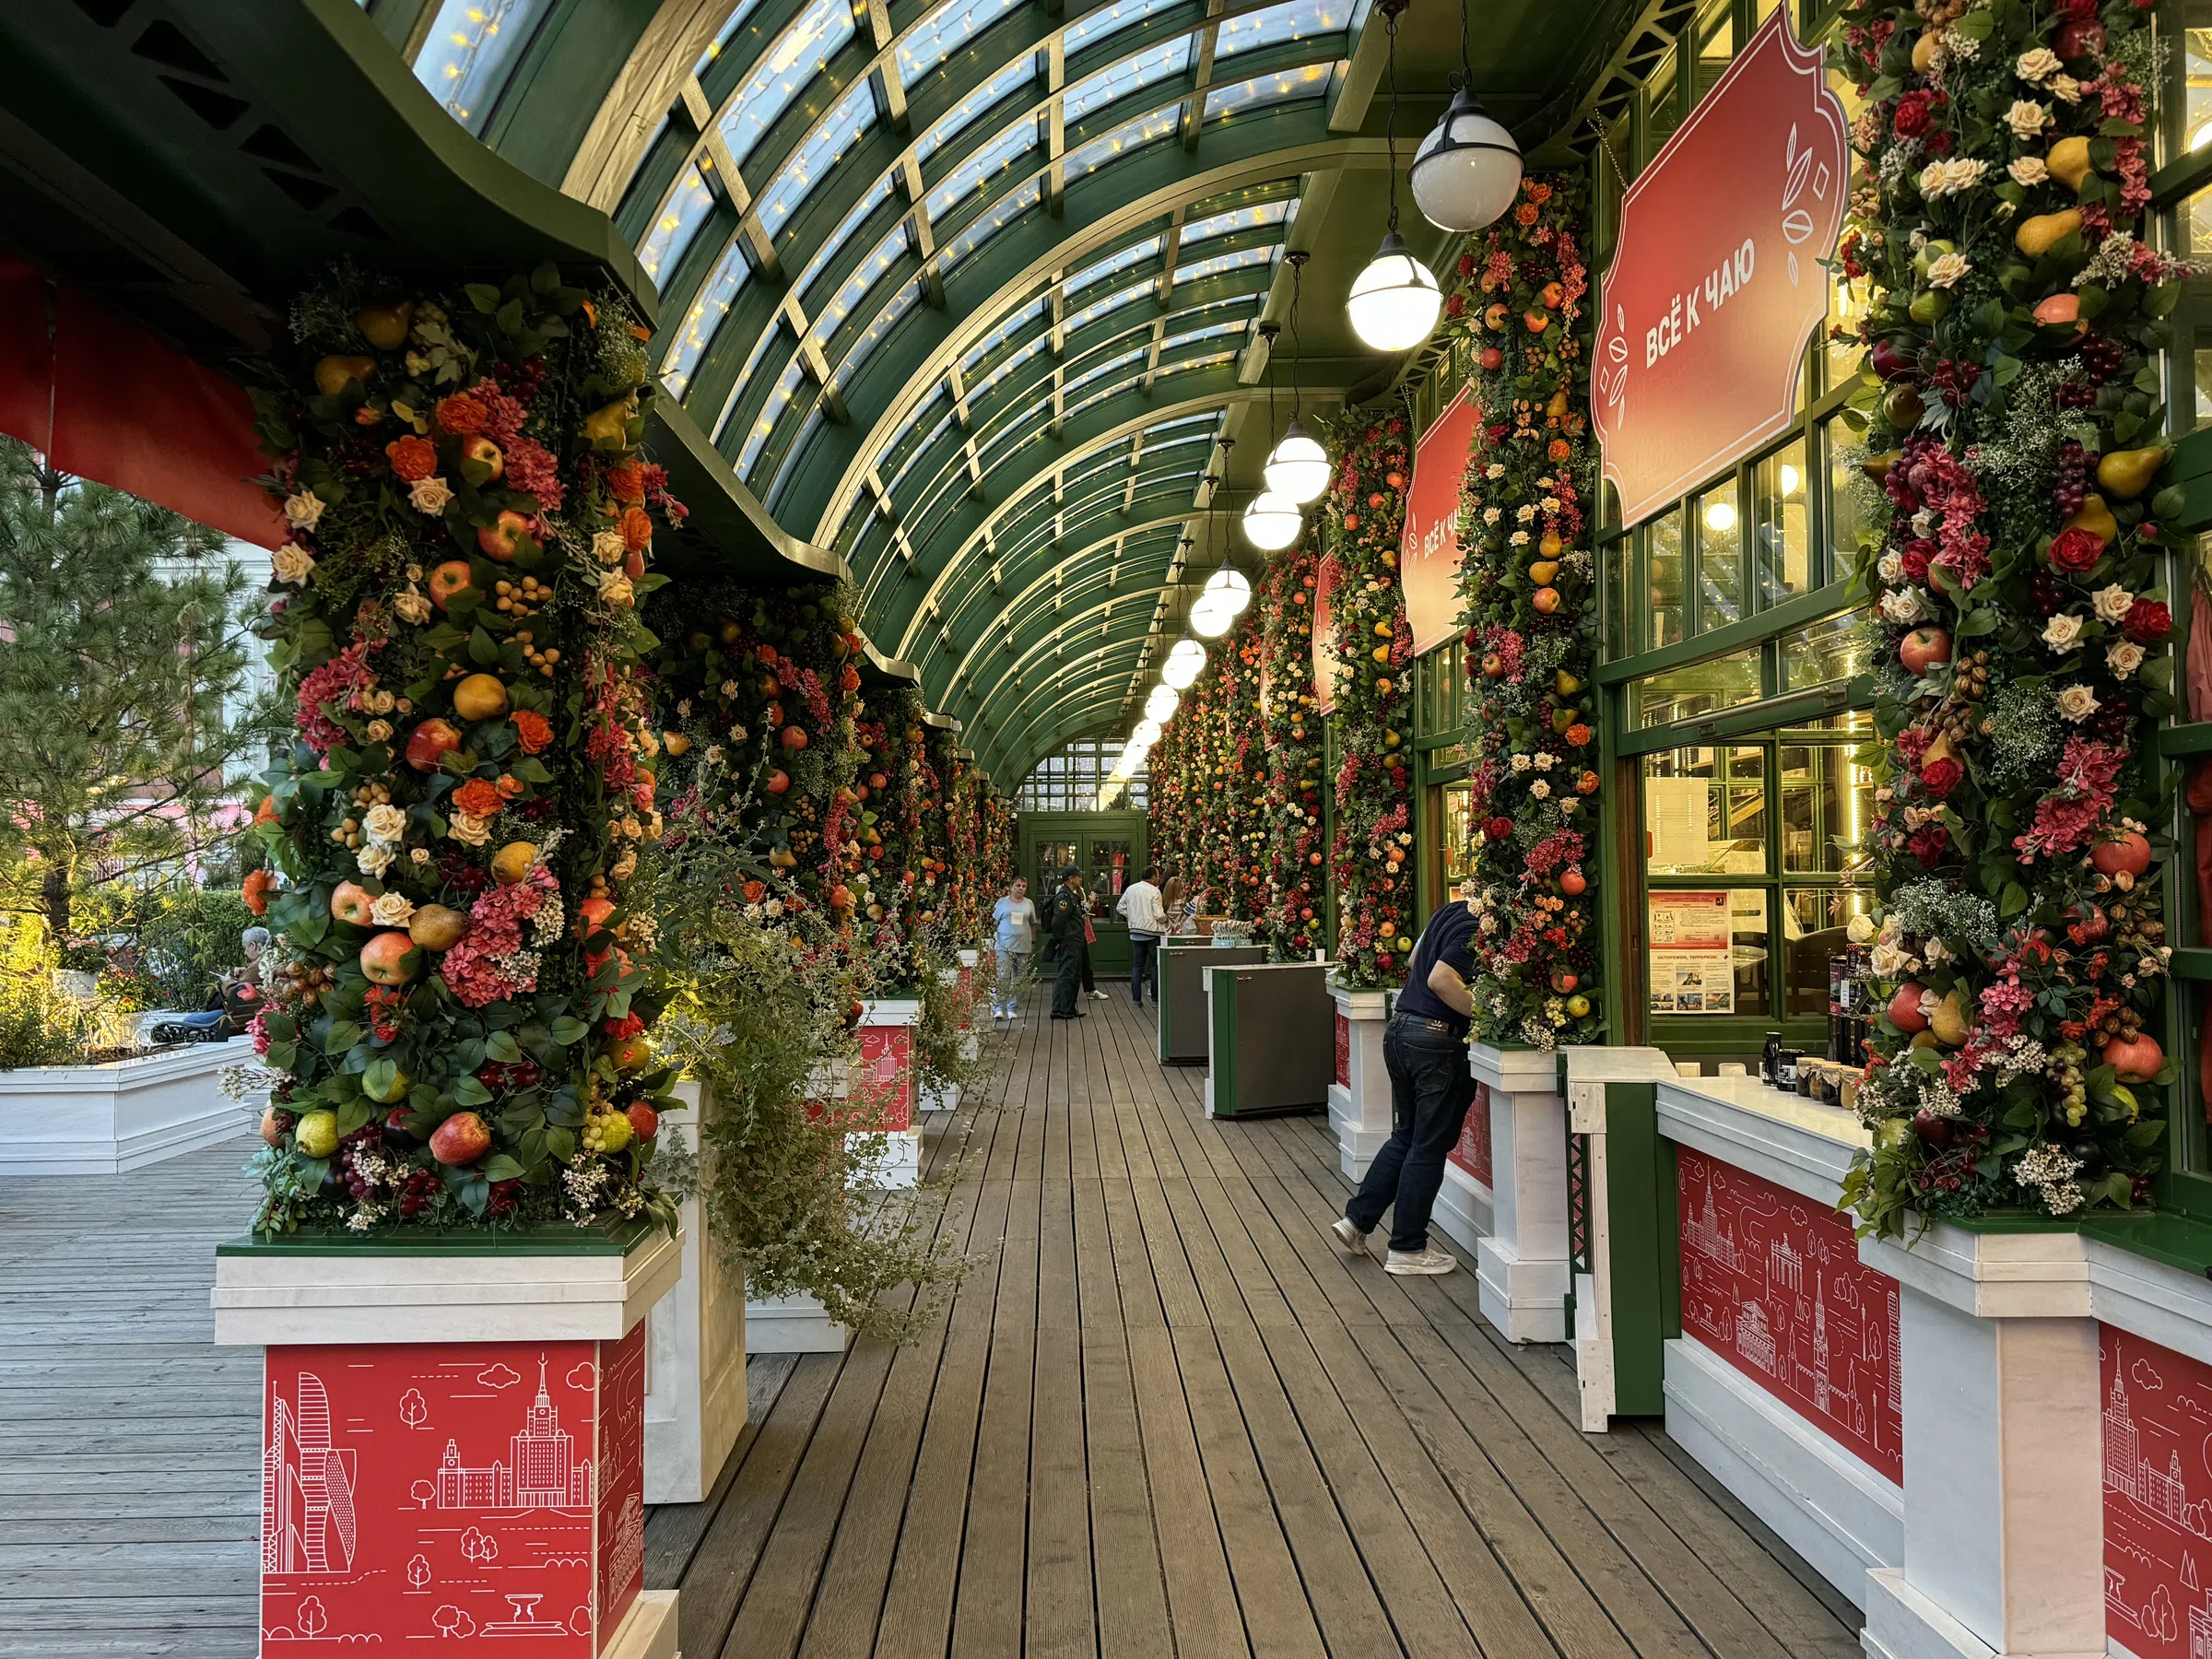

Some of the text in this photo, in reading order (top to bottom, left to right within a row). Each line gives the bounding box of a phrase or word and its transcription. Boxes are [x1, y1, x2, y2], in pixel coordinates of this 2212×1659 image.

[1646, 238, 1755, 370] ВСЁ К ЧАЮ
[1424, 505, 1462, 559] ВСЁ К ЧА
